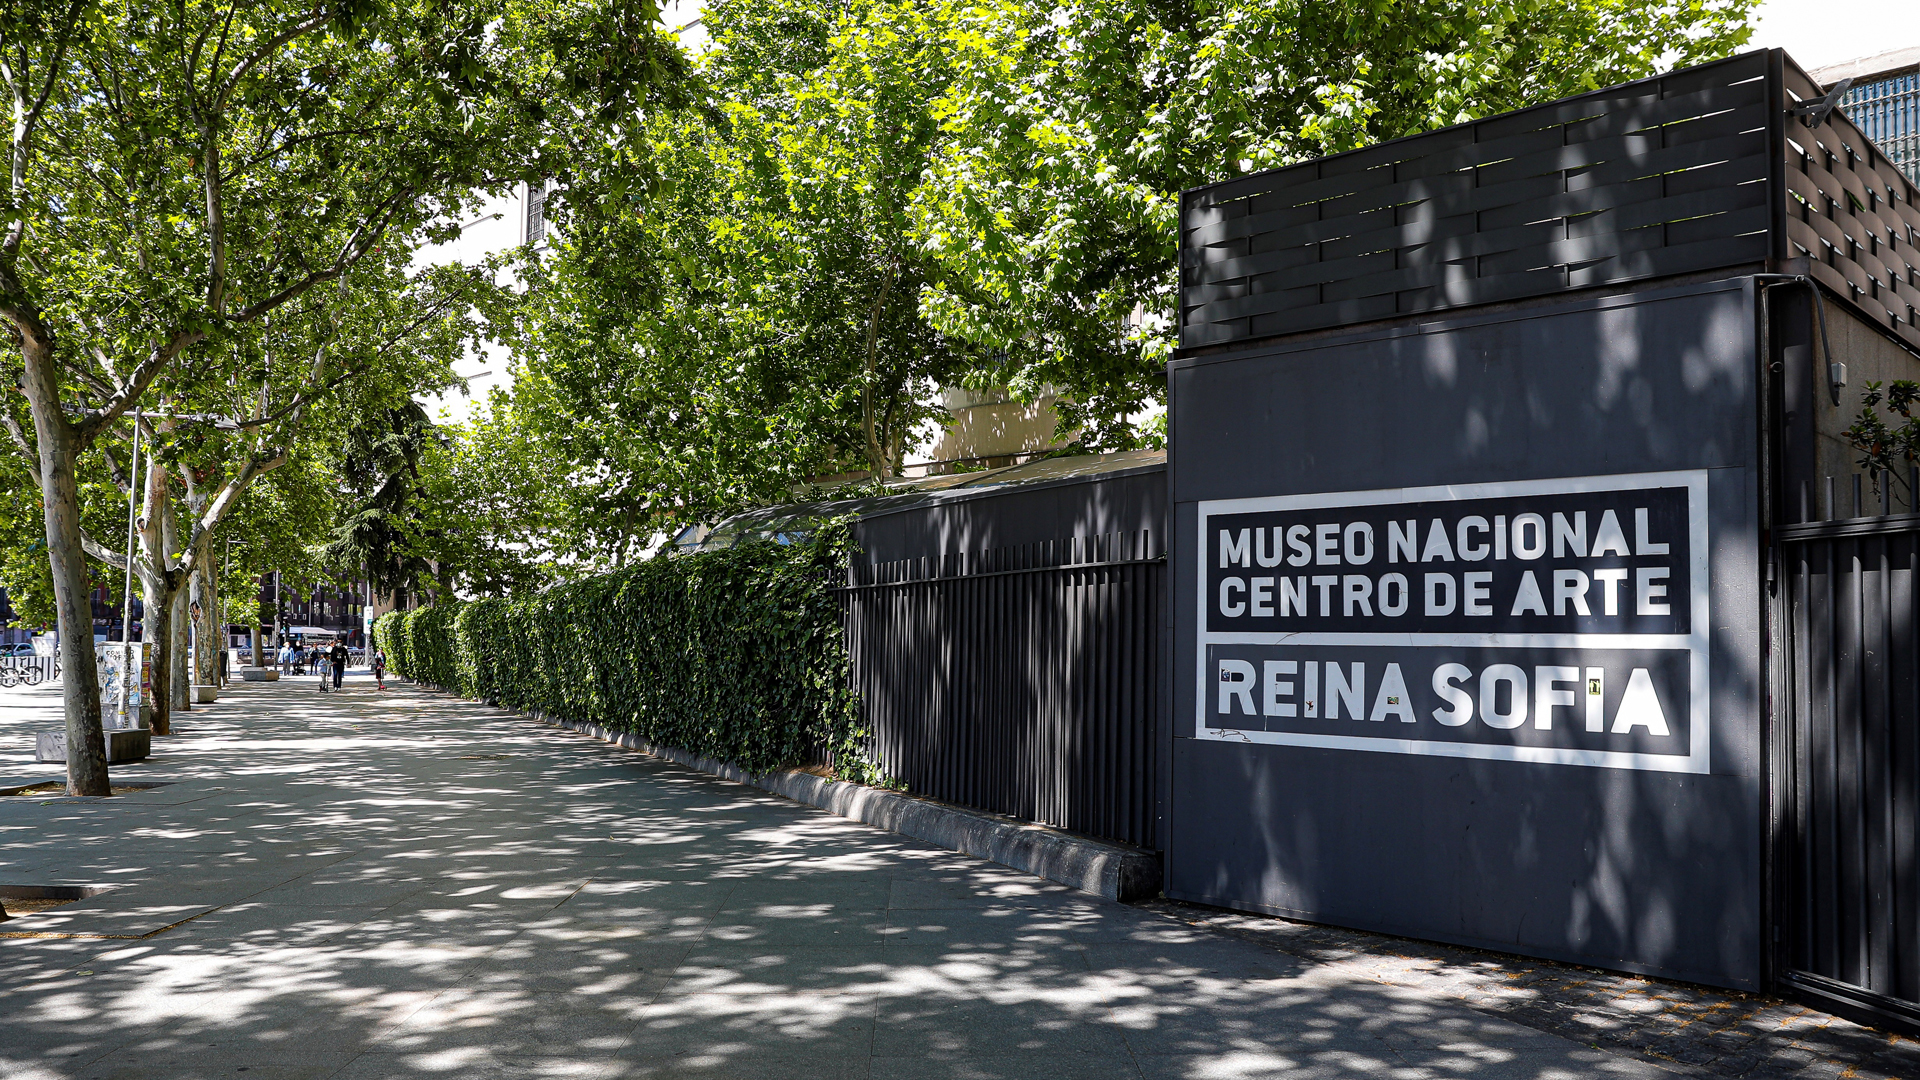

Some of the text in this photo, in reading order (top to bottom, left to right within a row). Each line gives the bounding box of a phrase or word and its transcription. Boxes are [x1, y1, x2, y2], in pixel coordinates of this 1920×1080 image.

[1219, 507, 1670, 569] MUSEO NACIONAL
[1219, 566, 1671, 618] CENTRO DE ARTE
[1218, 659, 1671, 736] REINA SOFIA
